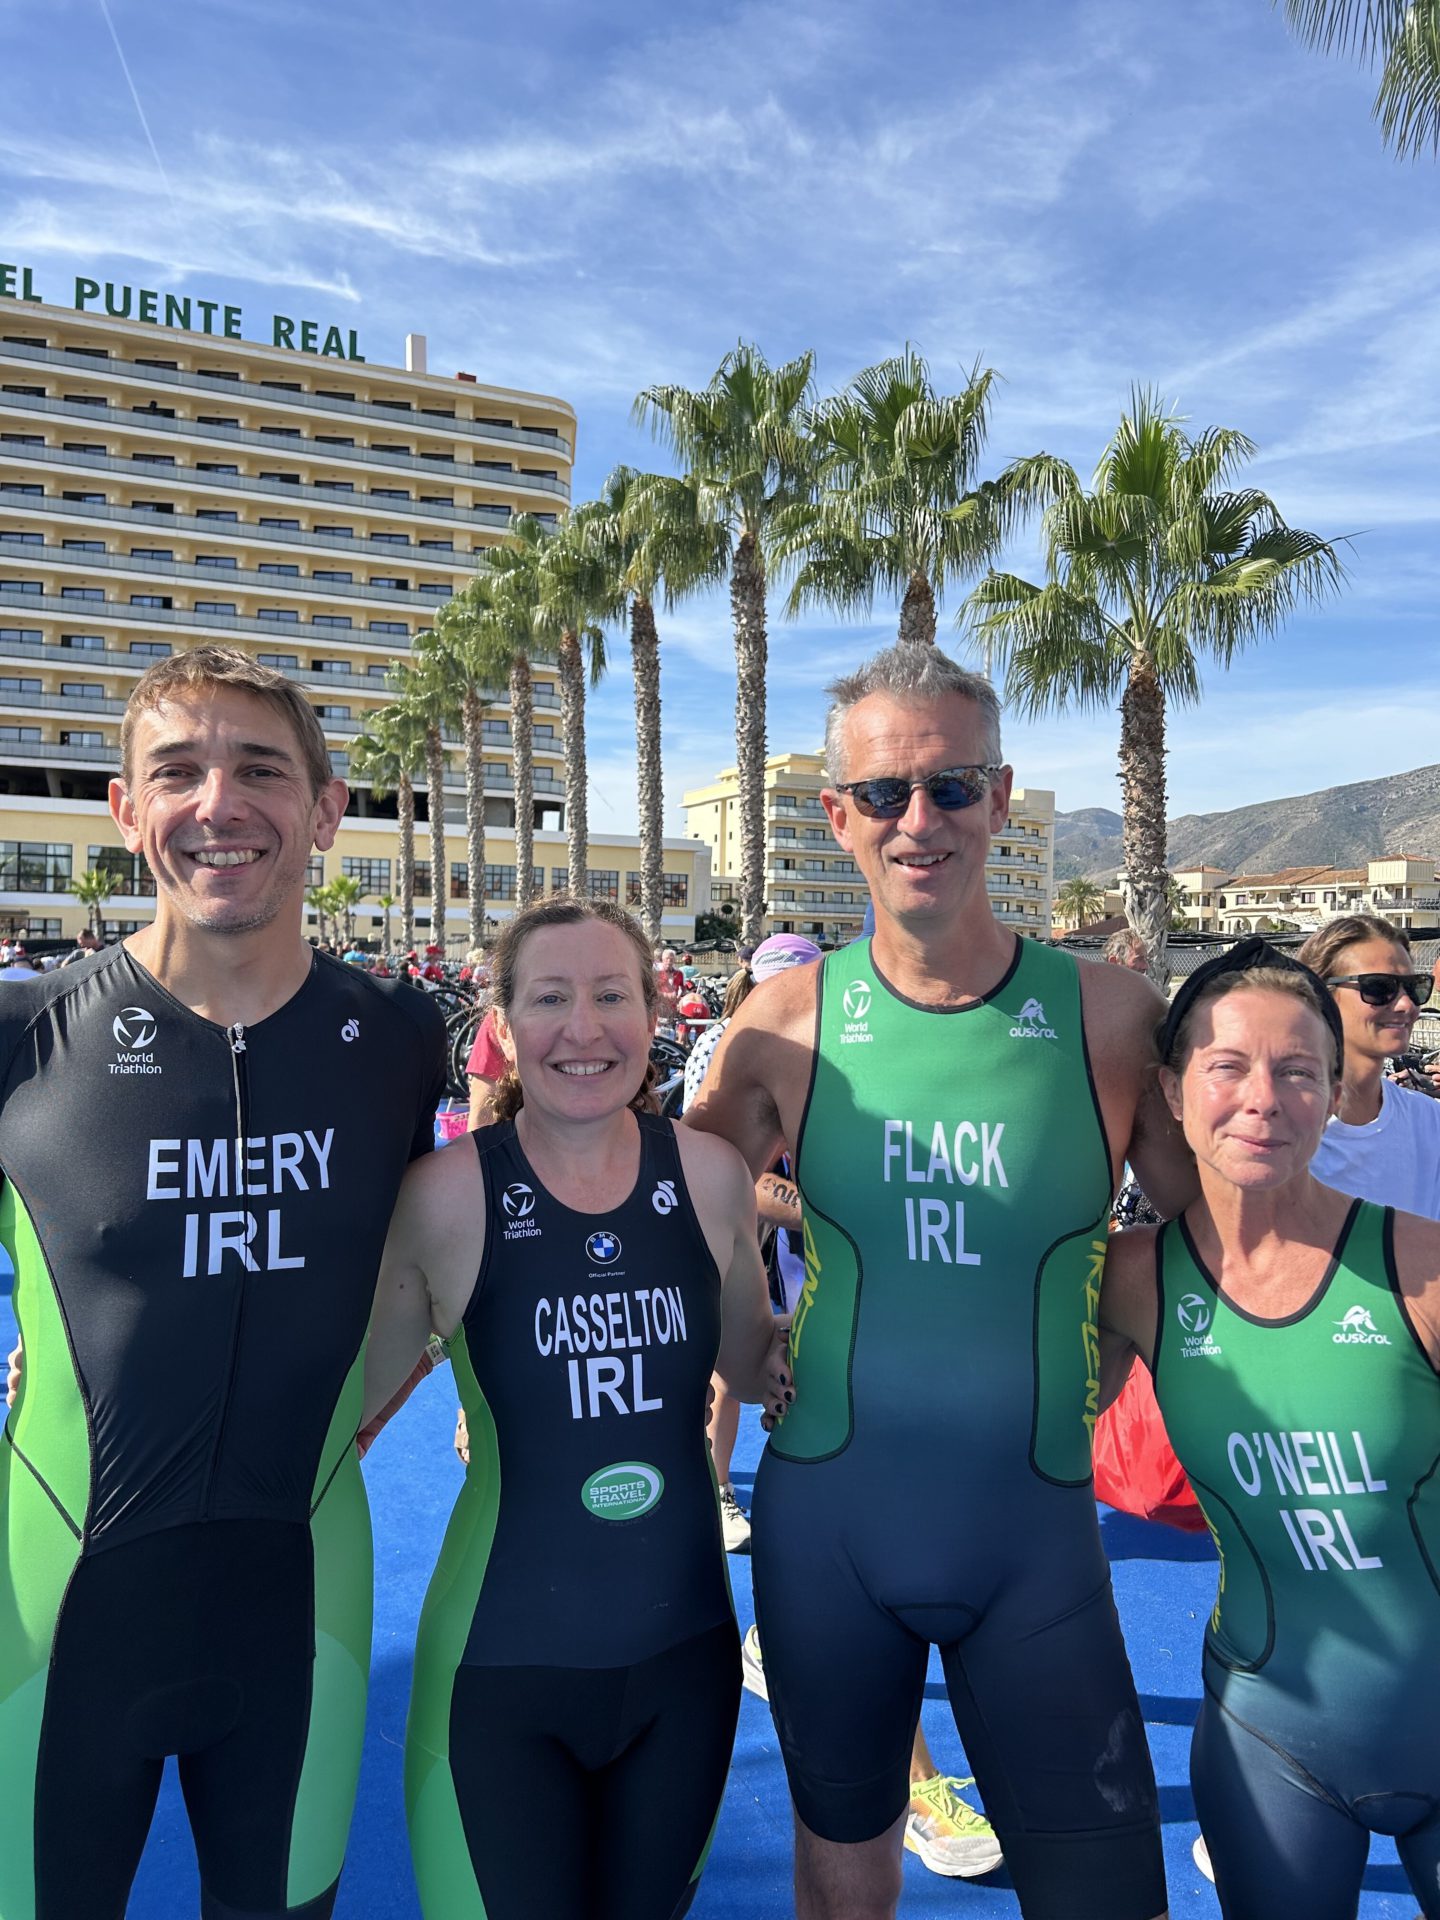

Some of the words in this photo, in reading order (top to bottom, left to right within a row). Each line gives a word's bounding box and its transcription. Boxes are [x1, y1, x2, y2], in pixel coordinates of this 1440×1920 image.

[75, 276, 243, 340] PUENTE
[273, 315, 366, 363] REAL
[844, 1021, 868, 1033] World
[839, 1032, 874, 1044] Triathlon
[117, 1052, 154, 1063] World
[107, 1063, 162, 1075] Triathlon
[883, 1120, 1008, 1188] FLACK
[146, 1127, 335, 1201] EMERY
[507, 1218, 536, 1230] World
[503, 1227, 542, 1241] Triathlon
[590, 1233, 615, 1243] BMW
[905, 1197, 981, 1266] IRL
[183, 1209, 305, 1278] IRL
[535, 1286, 687, 1357] CASSELTON
[1184, 1334, 1214, 1347] World
[1180, 1344, 1222, 1358] Triathlon
[567, 1353, 664, 1419] IRL
[1227, 1431, 1388, 1497] O'NEILL
[590, 1481, 645, 1495] SPORTS
[590, 1490, 645, 1503] TRAVEL
[592, 1497, 646, 1508] INTERNATIONAL
[1279, 1508, 1383, 1571] IRL
